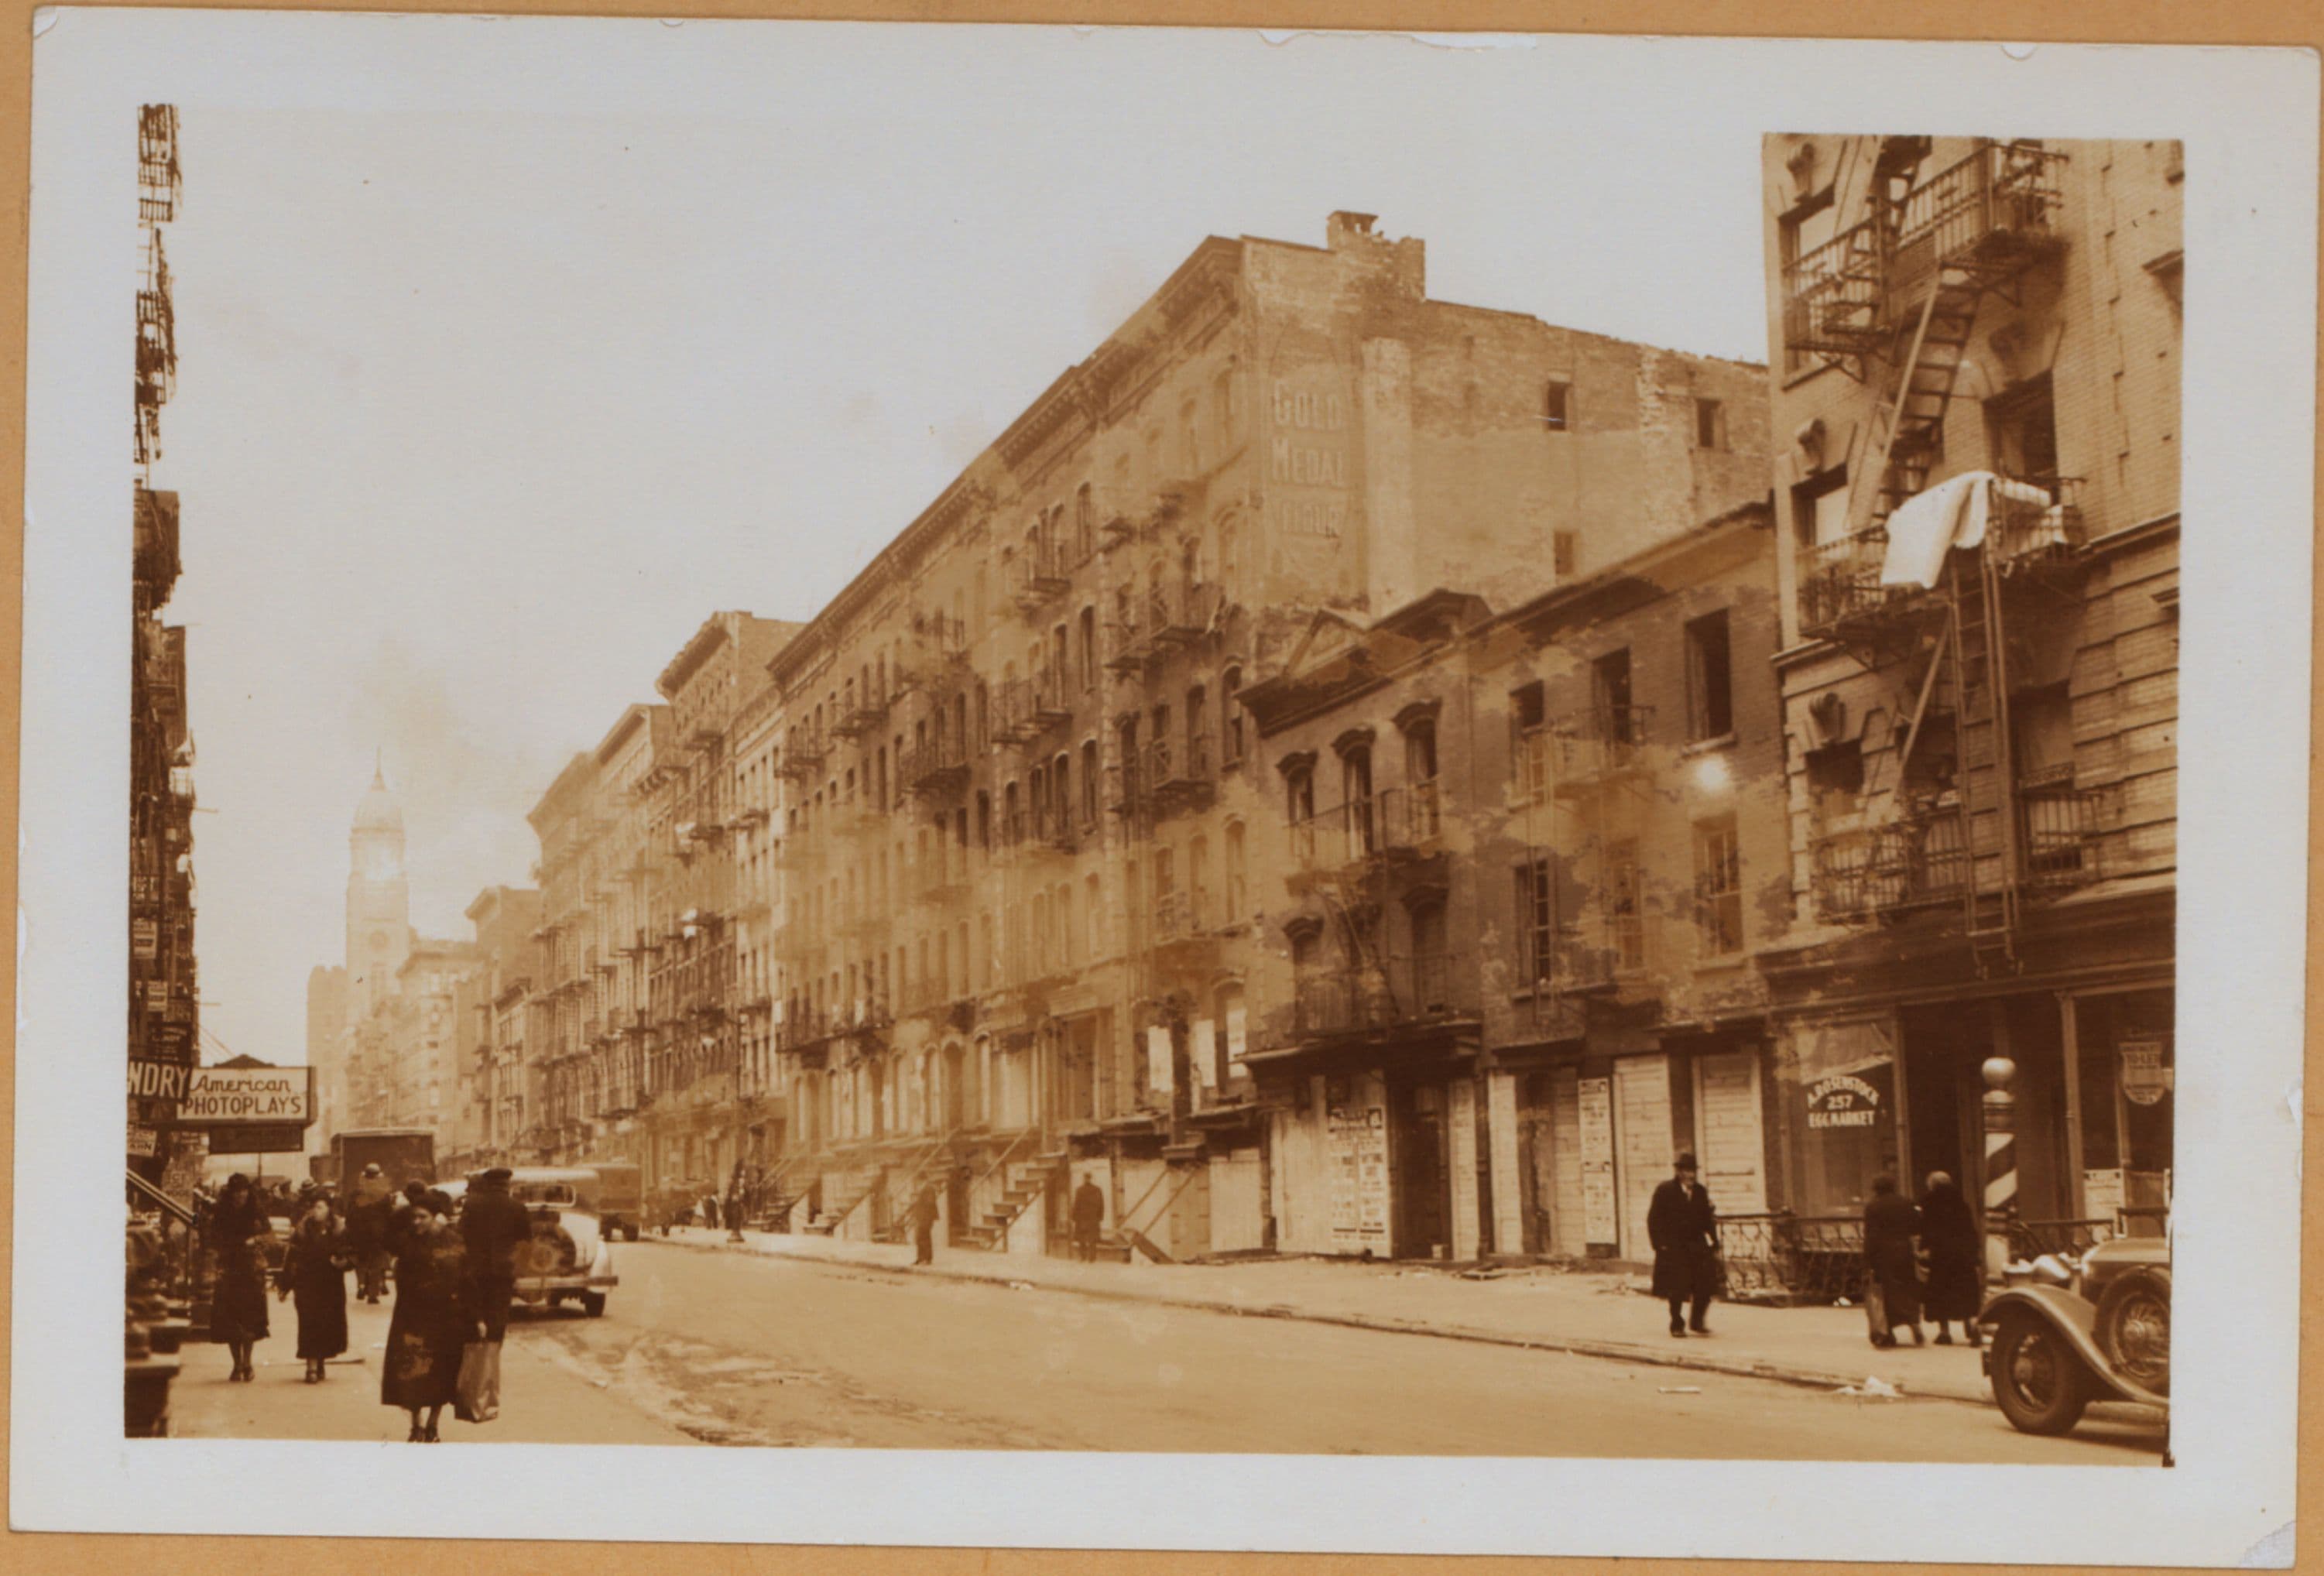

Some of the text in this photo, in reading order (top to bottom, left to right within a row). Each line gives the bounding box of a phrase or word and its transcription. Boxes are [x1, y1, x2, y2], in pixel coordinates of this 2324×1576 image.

[128, 1061, 188, 1098] NDRY
[190, 1075, 291, 1092] American
[182, 1095, 301, 1115] PHOTOPLAYS
[1827, 1095, 1853, 1110] 257
